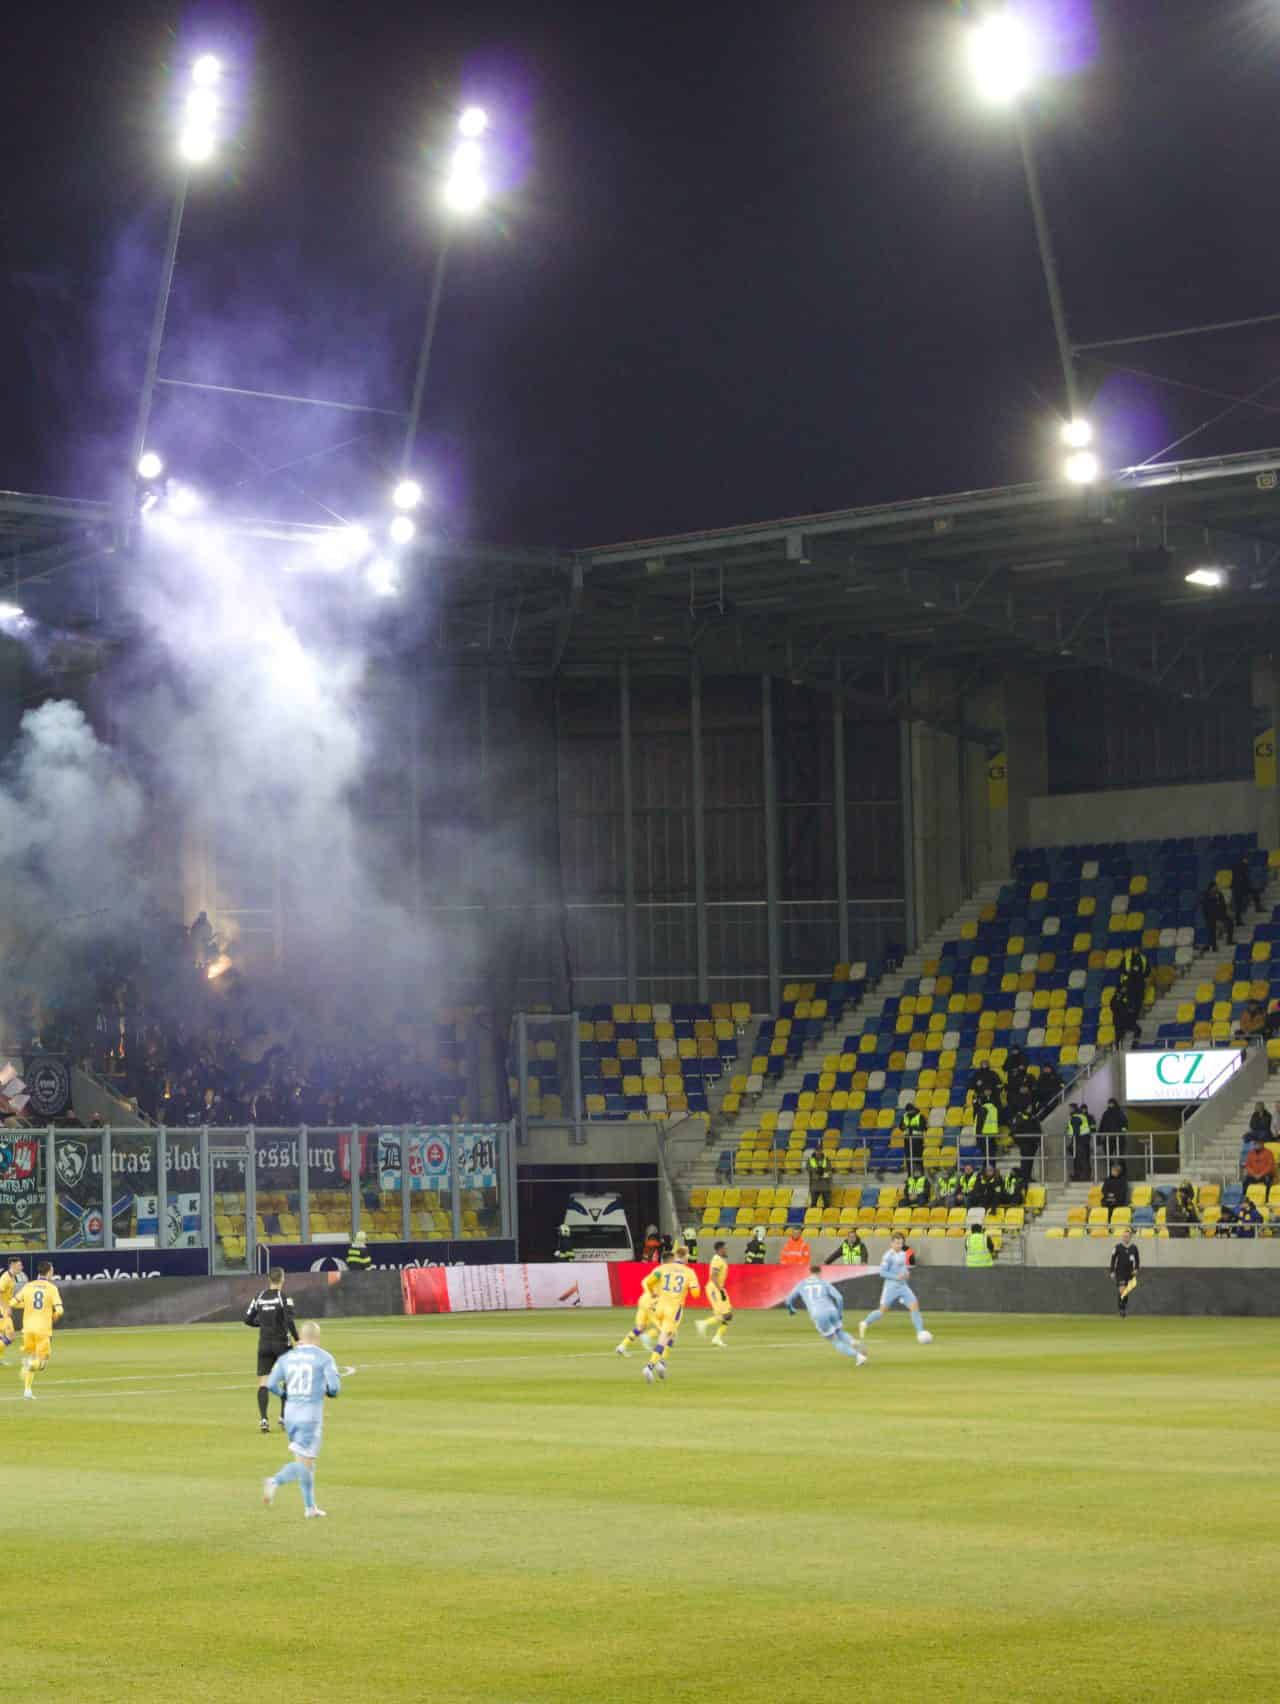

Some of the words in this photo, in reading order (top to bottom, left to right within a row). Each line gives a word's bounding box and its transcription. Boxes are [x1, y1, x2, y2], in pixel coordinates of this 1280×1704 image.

[1156, 1053, 1206, 1086] CZ
[662, 1273, 685, 1294] 13
[33, 1290, 44, 1310] 8
